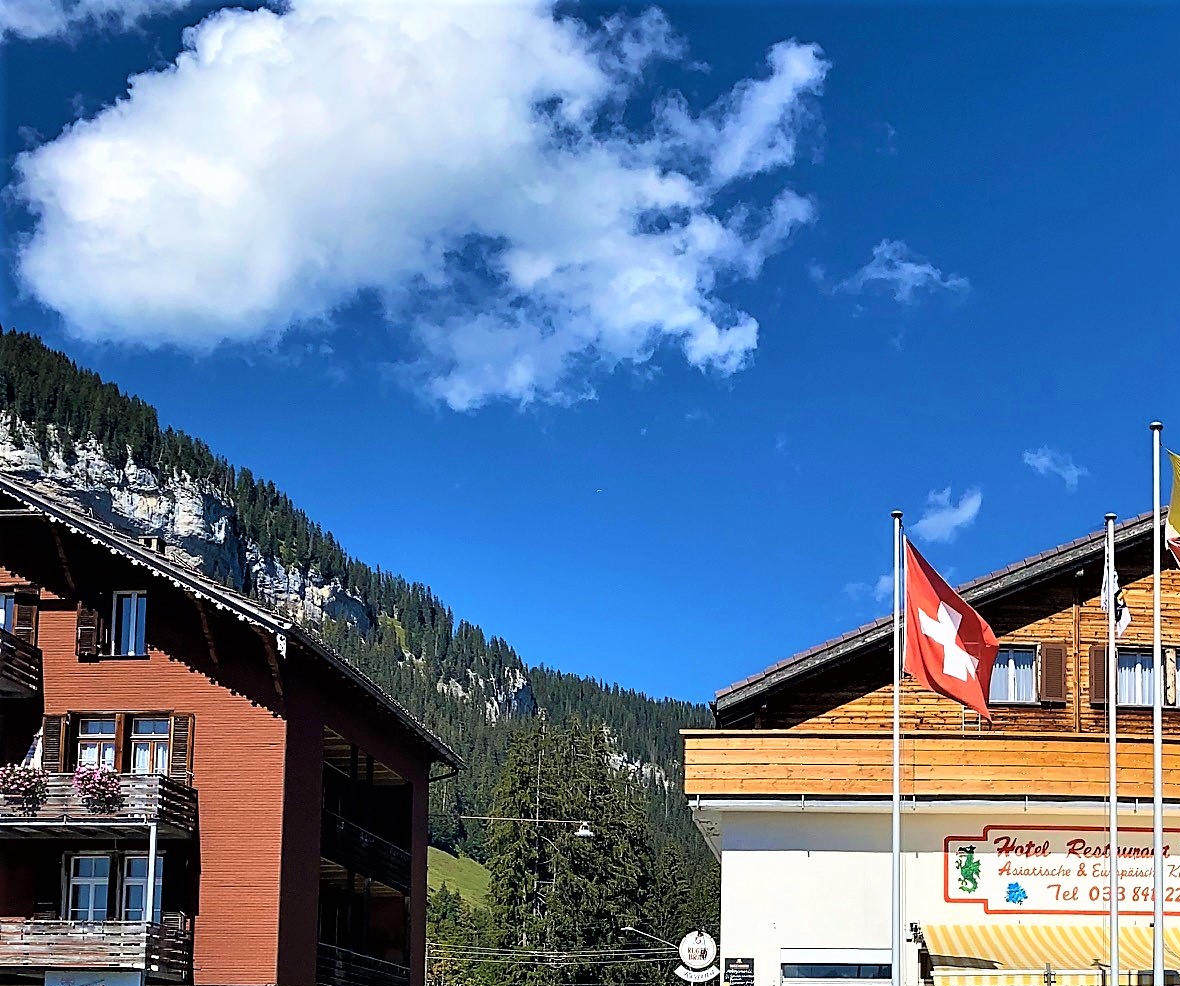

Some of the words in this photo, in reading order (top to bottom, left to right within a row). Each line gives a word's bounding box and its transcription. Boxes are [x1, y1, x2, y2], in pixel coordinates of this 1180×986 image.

[993, 836, 1051, 858] Hotel
[998, 860, 1071, 877] Asiatische
[1077, 862, 1087, 877] &
[1046, 884, 1079, 901] Tel
[1088, 885, 1126, 902] 033
